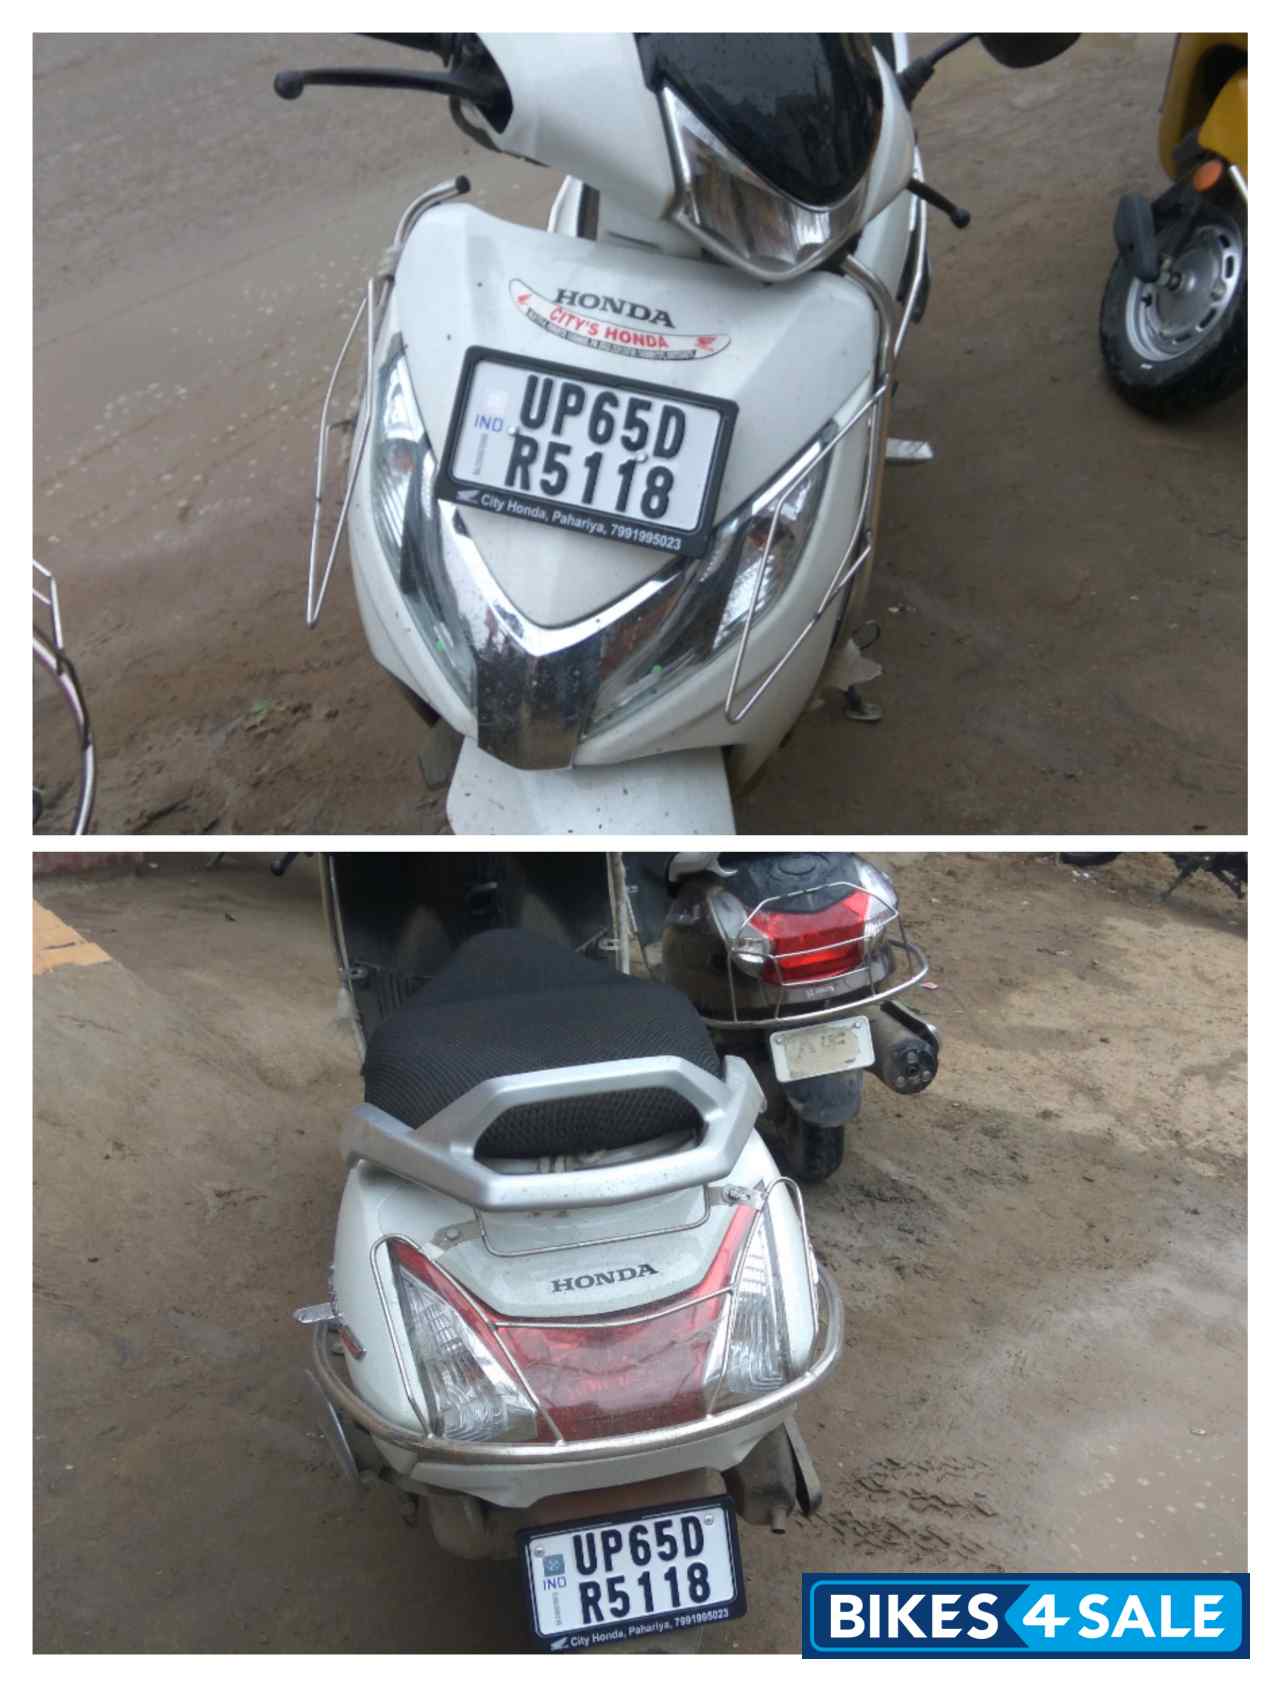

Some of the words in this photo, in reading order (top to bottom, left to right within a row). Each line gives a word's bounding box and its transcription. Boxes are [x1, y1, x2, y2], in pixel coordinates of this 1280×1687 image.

[550, 304, 598, 336] CITY'S
[605, 328, 670, 349] HONDA
[553, 288, 676, 328] HONDA
[473, 414, 504, 432] IND
[520, 375, 686, 459] UP65D
[504, 434, 674, 519] R5118
[481, 494, 505, 511] City
[507, 499, 549, 522] Honda,
[552, 511, 607, 535] Pahariya,
[610, 523, 682, 550] 7991995023
[551, 1264, 660, 1292] HONDA
[572, 1515, 704, 1576] UP65D
[543, 1576, 567, 1590] IND
[579, 1562, 711, 1624] R5118
[570, 1635, 590, 1648] City
